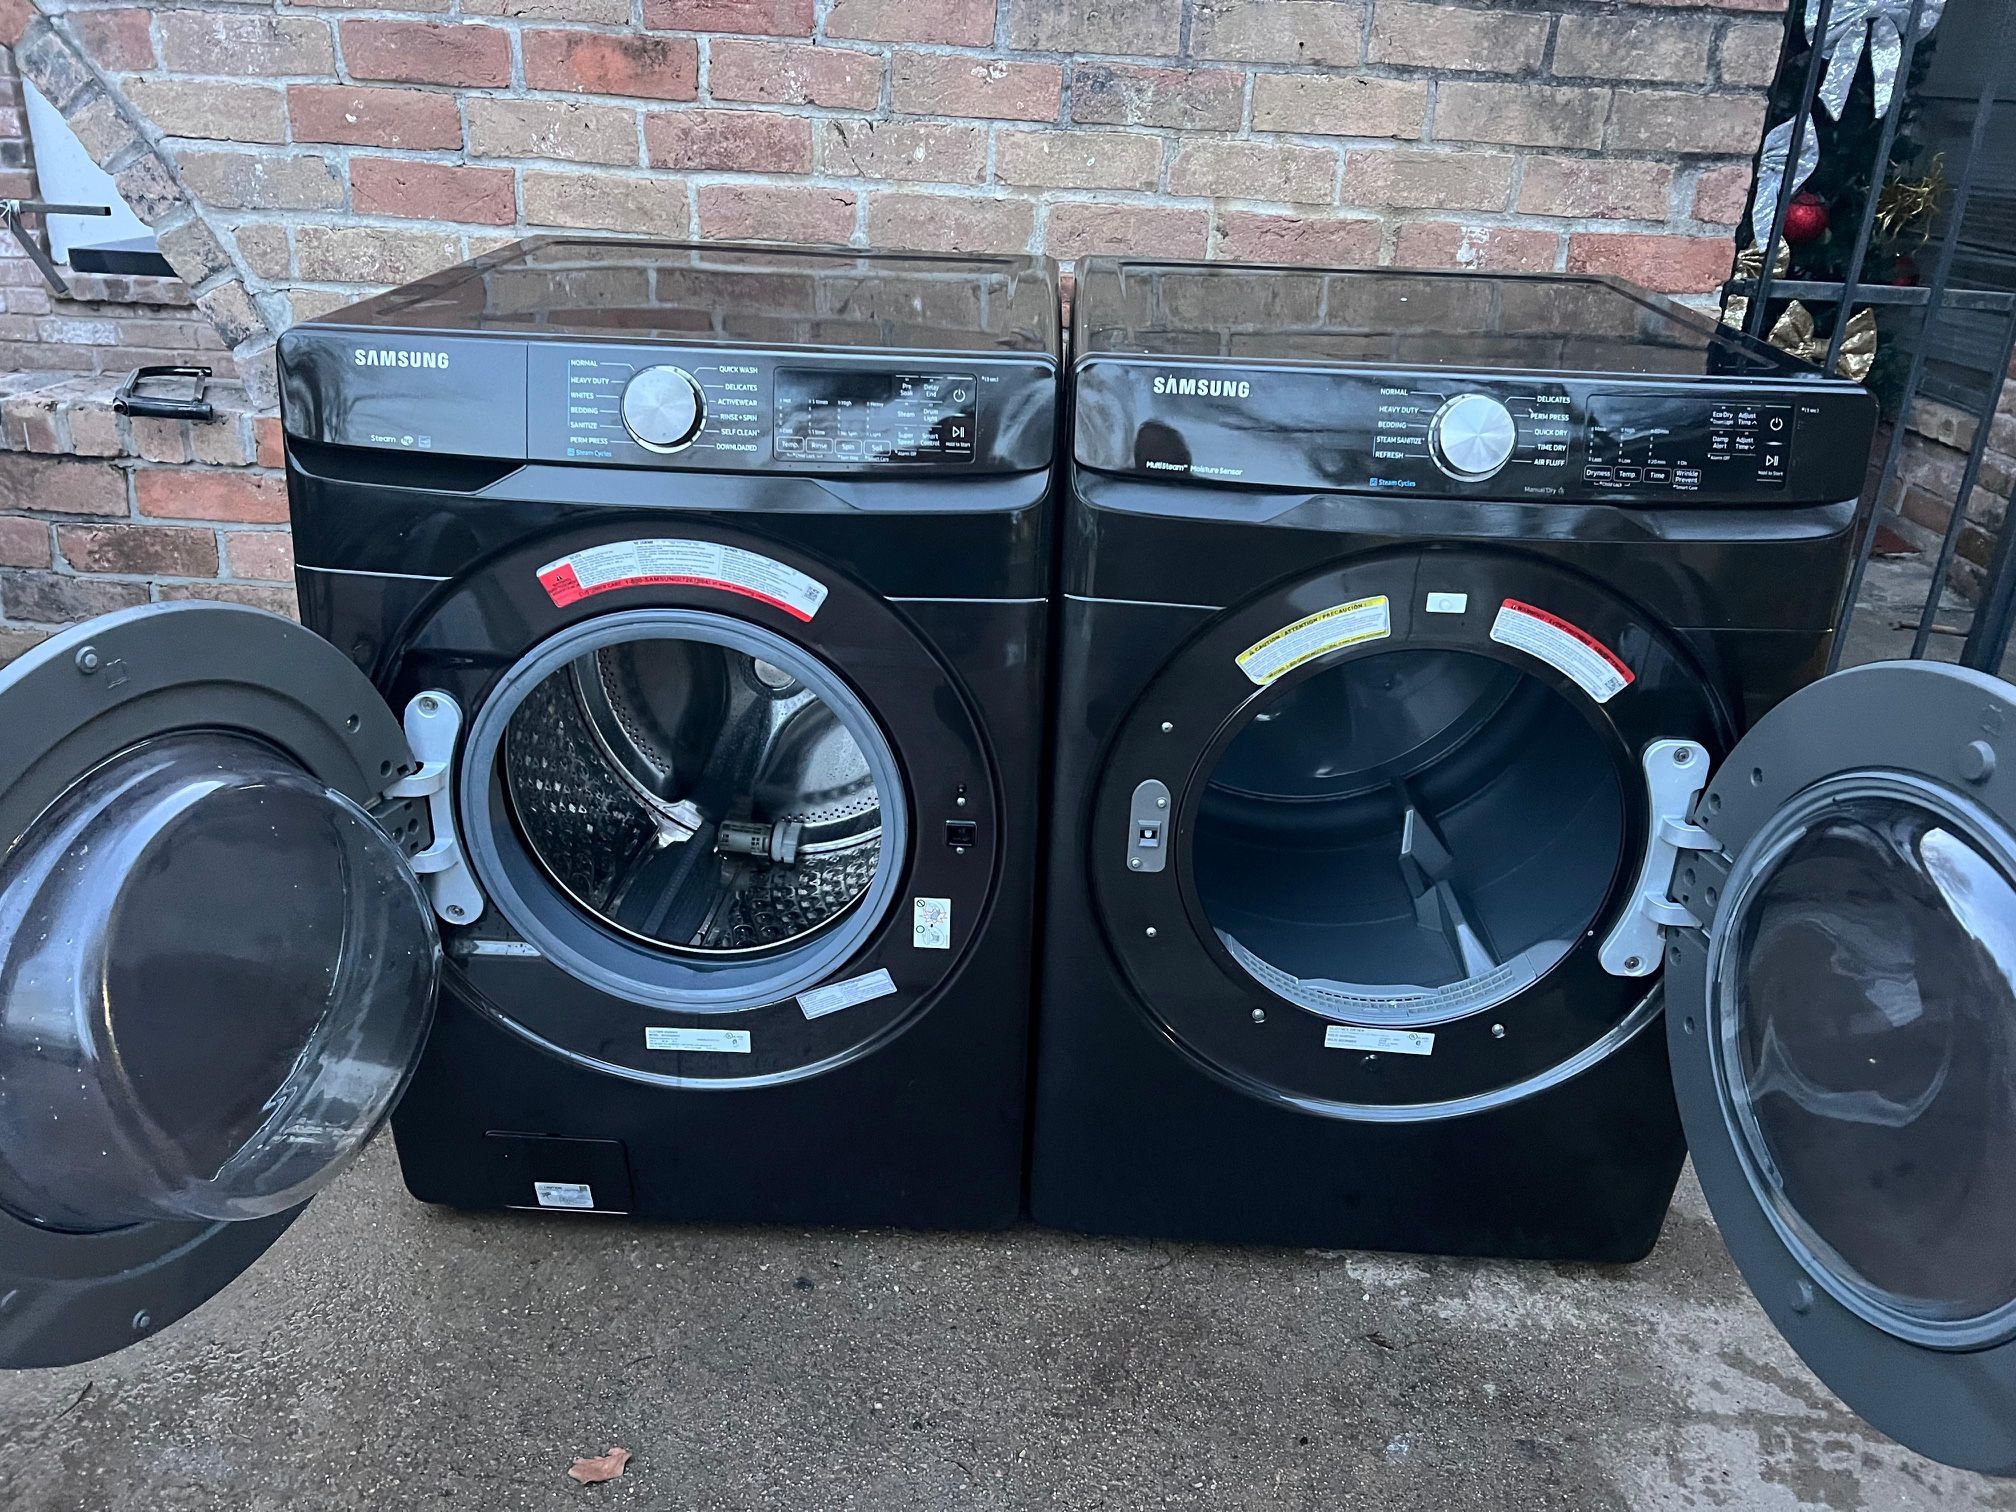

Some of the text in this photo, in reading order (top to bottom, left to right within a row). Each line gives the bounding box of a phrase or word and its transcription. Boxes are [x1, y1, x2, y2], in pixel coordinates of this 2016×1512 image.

[355, 349, 449, 368] SAMSUNG
[1153, 377, 1250, 398] SAMSUNG
[370, 434, 396, 442] Steam
[716, 443, 757, 451] DOWNLOADED
[1190, 465, 1219, 474] Moisture
[1220, 467, 1243, 476] Sensor
[1587, 470, 1610, 478] Dryness
[1255, 635, 1280, 651] CAUTION
[1284, 618, 1318, 635] ATTENTION
